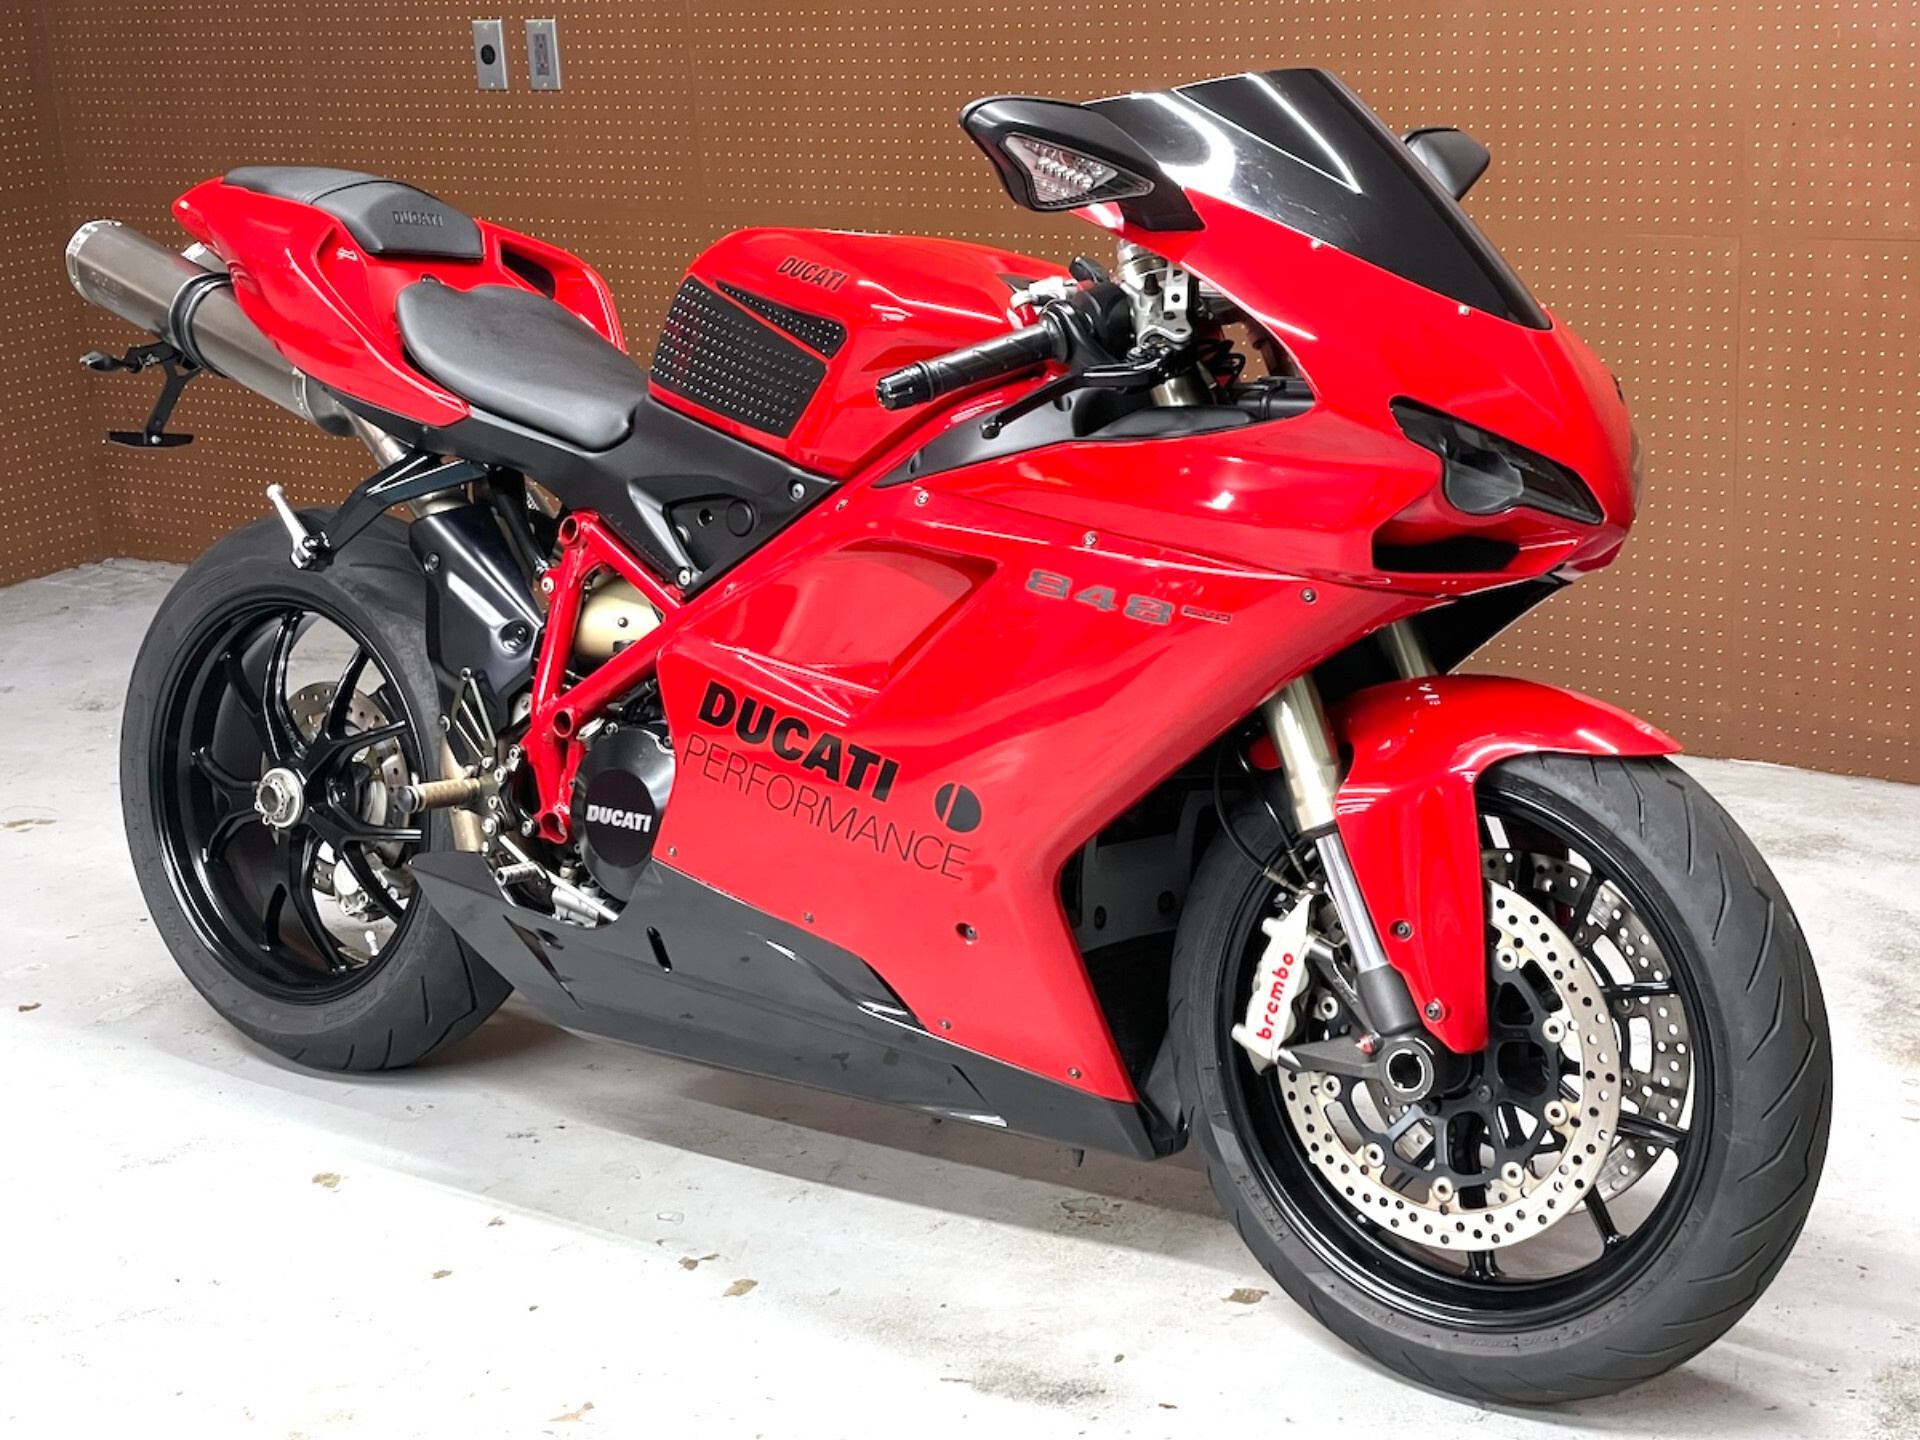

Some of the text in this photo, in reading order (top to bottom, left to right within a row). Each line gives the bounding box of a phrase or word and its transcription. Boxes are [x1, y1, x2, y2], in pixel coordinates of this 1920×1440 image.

[392, 211, 444, 227] DUCATI
[777, 257, 848, 291] DUCATI
[1026, 569, 1175, 624] 848
[698, 681, 899, 802] DUCATI
[586, 805, 652, 833] DUCATI
[683, 734, 971, 881] PERFORMANCE
[1256, 953, 1294, 1039] brembo
